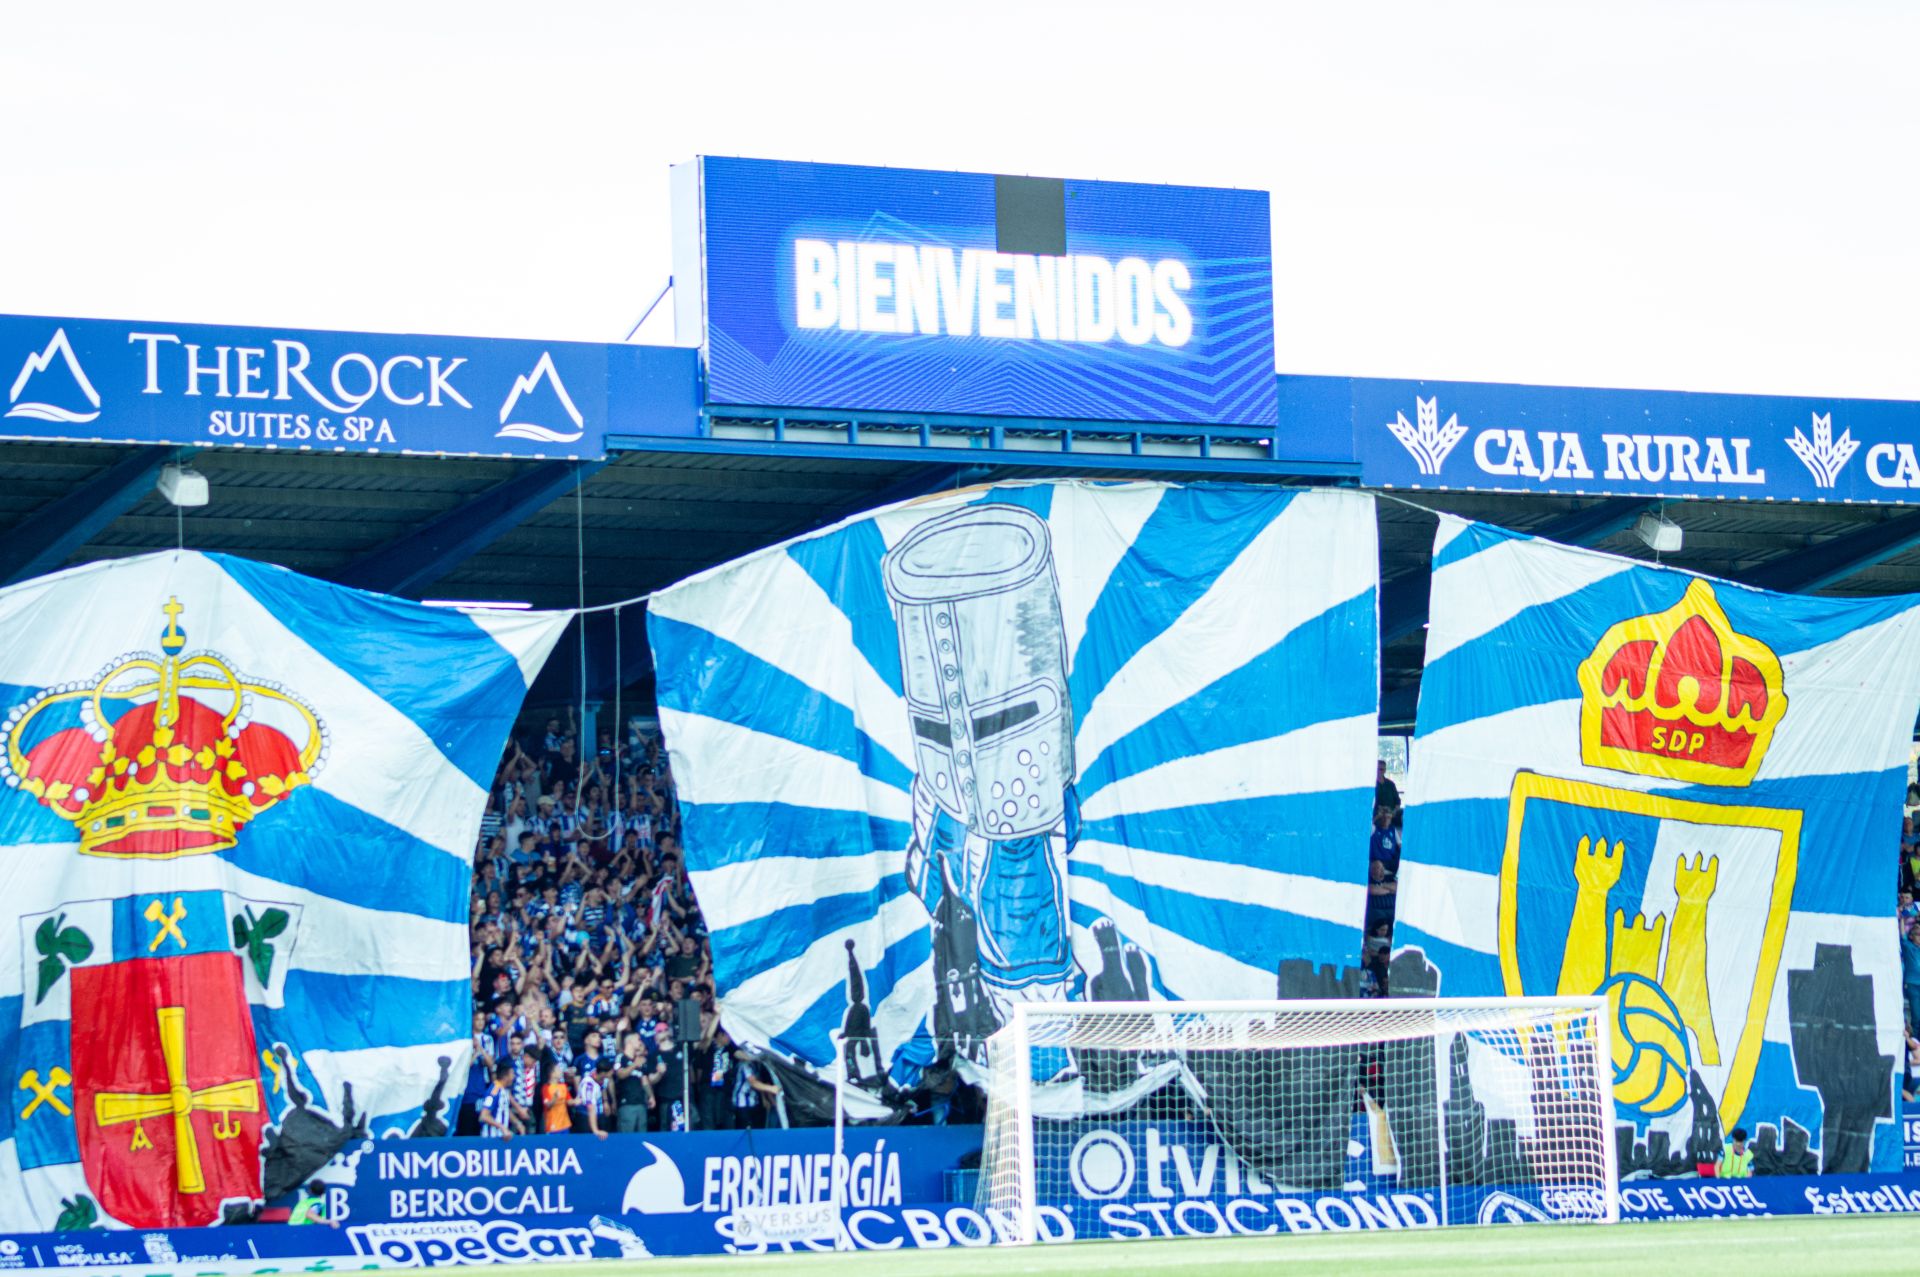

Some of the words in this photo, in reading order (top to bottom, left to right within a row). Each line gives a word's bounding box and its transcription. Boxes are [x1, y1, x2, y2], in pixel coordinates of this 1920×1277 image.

[795, 239, 1193, 346] BIENVENIDOS
[209, 410, 310, 440] SUITES
[316, 413, 337, 440] &
[344, 416, 396, 443] SPA
[1474, 429, 1594, 482] CAJA
[1603, 434, 1765, 484] RURAL
[1652, 726, 1704, 754] SDP
[379, 1147, 582, 1180] INMOBILIARIA
[703, 1139, 901, 1212] ERBIENERGÍA
[390, 1185, 573, 1218] BERROCALL
[1679, 1185, 1767, 1210] HOTEL
[372, 1224, 478, 1237] ELEVACIONES
[754, 1208, 832, 1228] VERSUS
[57, 1251, 133, 1267] IMPULSA
